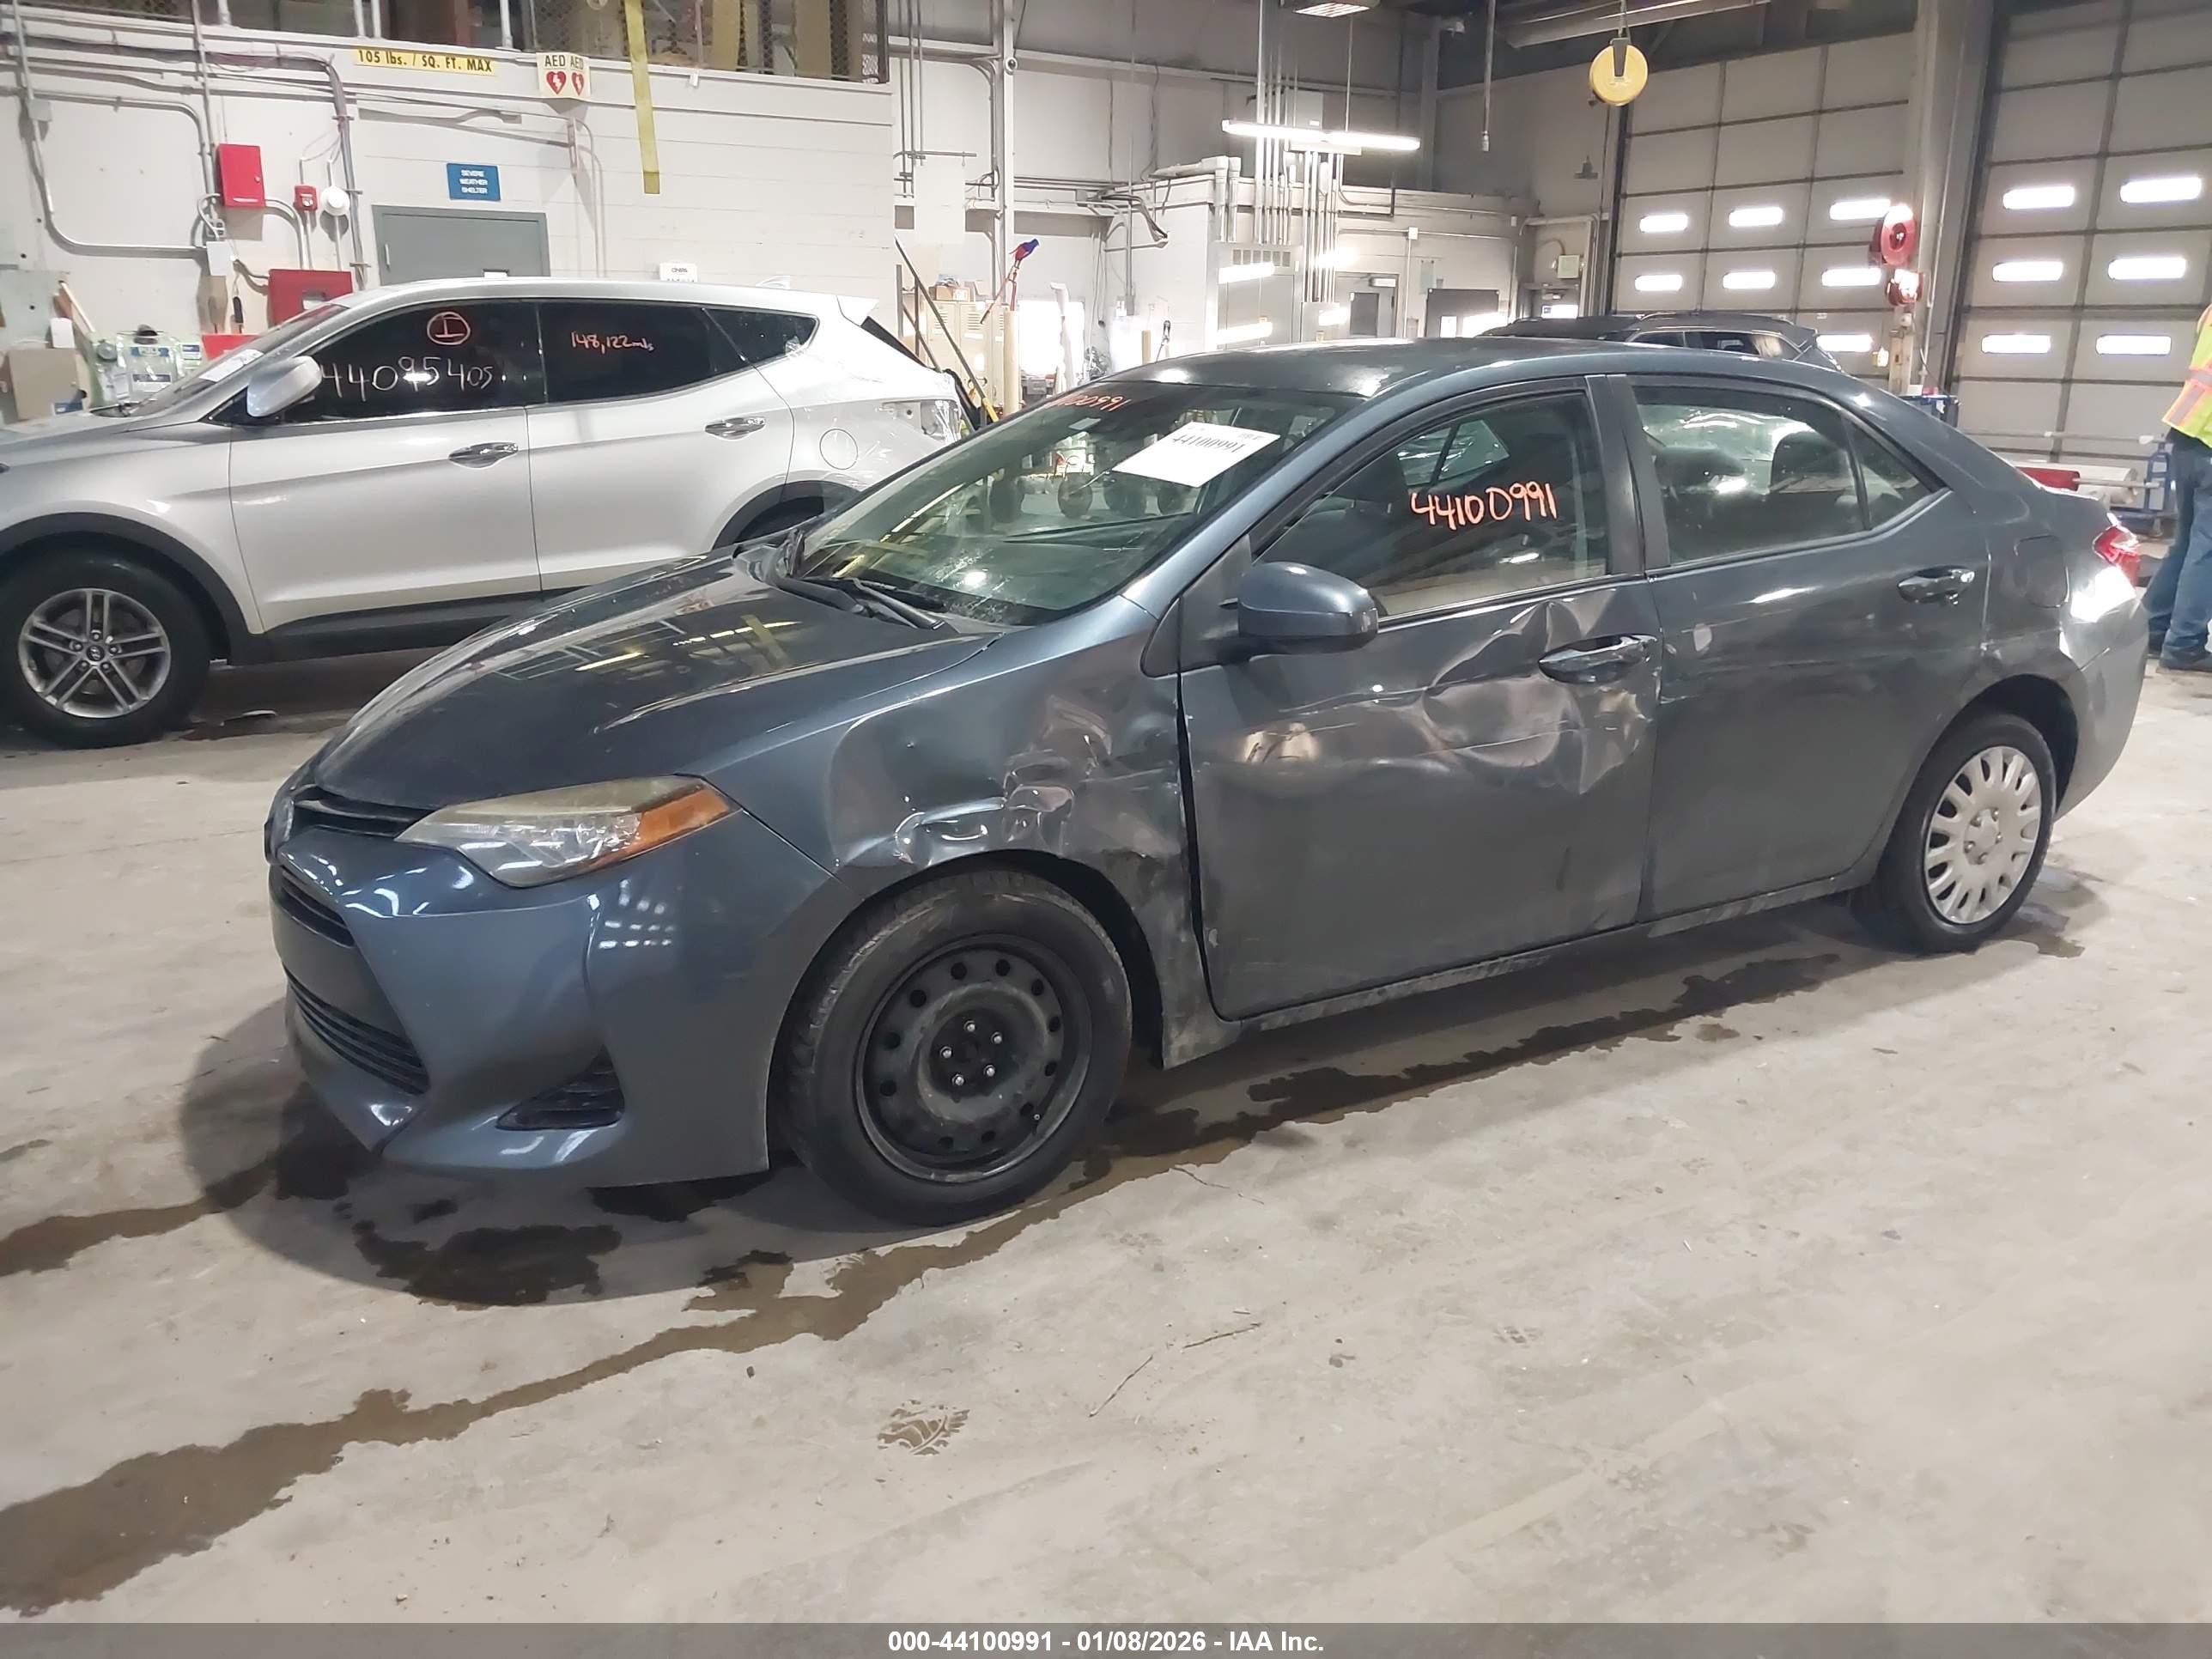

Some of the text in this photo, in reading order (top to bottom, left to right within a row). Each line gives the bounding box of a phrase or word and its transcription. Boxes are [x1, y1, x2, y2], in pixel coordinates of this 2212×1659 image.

[358, 50, 380, 64] 105
[385, 51, 408, 65] lbs.
[422, 55, 441, 68] SQ.
[446, 57, 462, 70] FT.
[466, 58, 492, 72] MAX
[544, 54, 566, 67] AED
[570, 56, 585, 70] AED
[1410, 480, 1558, 531] 44100991
